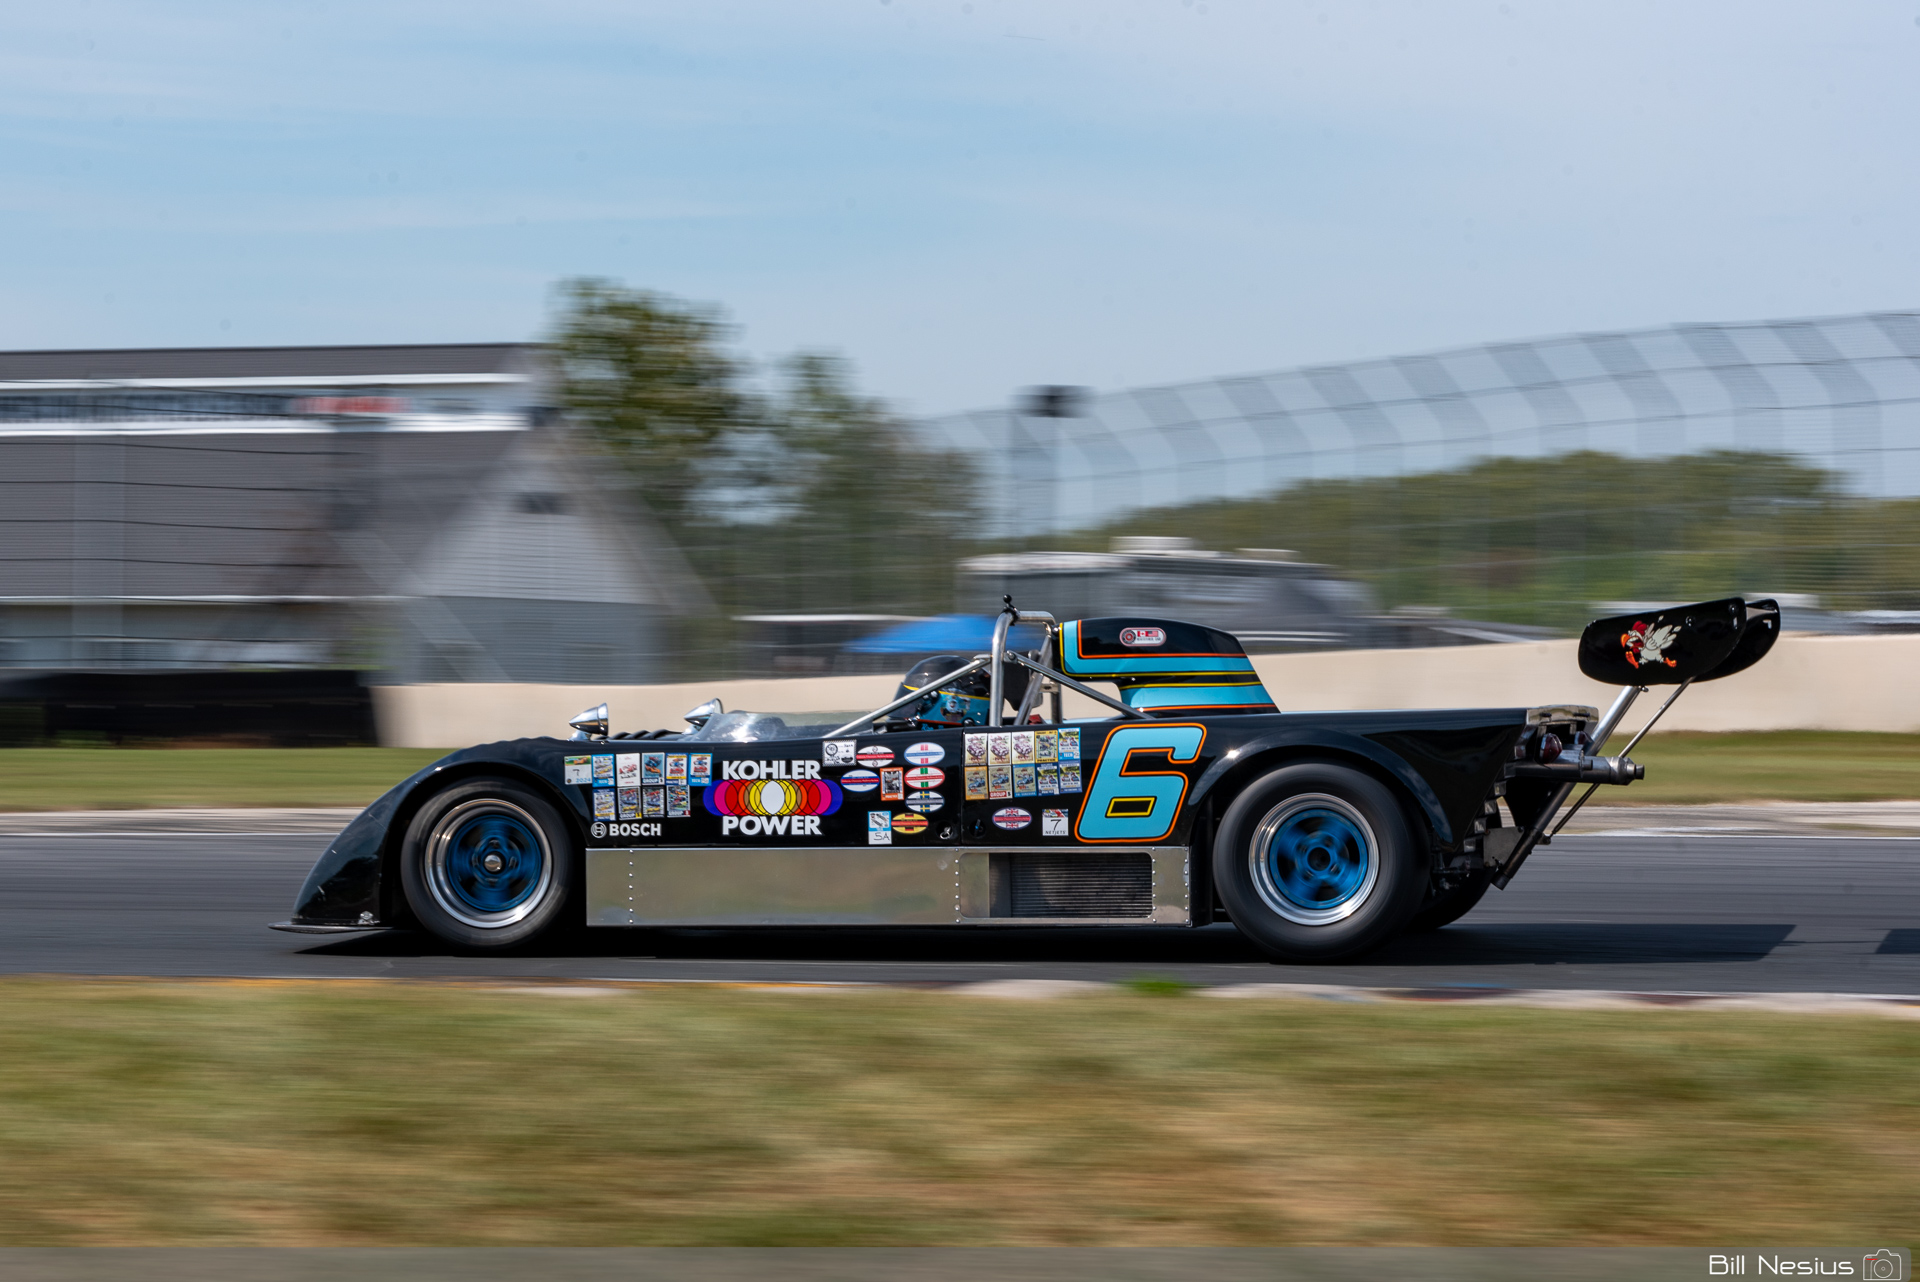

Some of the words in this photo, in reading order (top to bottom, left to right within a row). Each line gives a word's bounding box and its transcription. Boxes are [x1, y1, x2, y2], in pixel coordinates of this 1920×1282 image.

[722, 760, 822, 780] KOHLER
[1074, 722, 1207, 844] 6
[608, 823, 662, 837] BOSCH
[722, 816, 822, 836] POWER
[1050, 818, 1062, 831] 7
